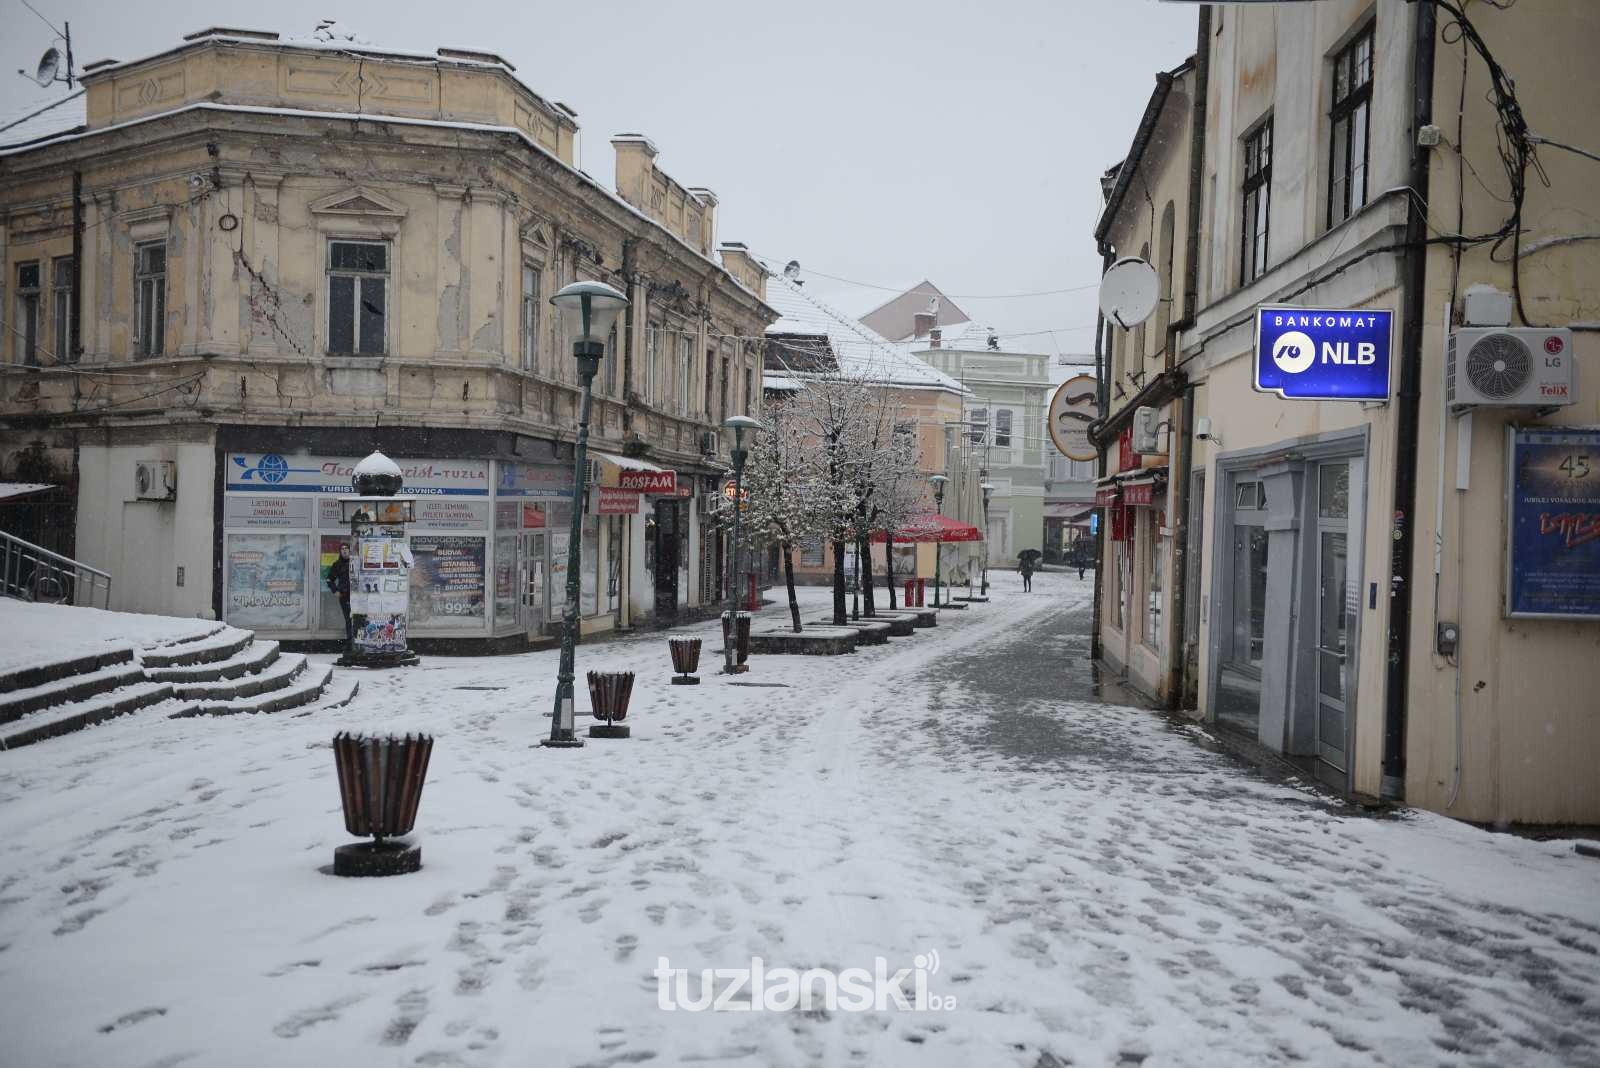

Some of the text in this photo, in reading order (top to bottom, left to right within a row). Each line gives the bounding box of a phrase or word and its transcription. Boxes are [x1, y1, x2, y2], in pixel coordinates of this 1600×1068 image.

[1275, 316, 1376, 328] BANKOMAT
[1321, 341, 1376, 365] NLB
[1545, 357, 1561, 368] LG
[1558, 455, 1590, 478] 45
